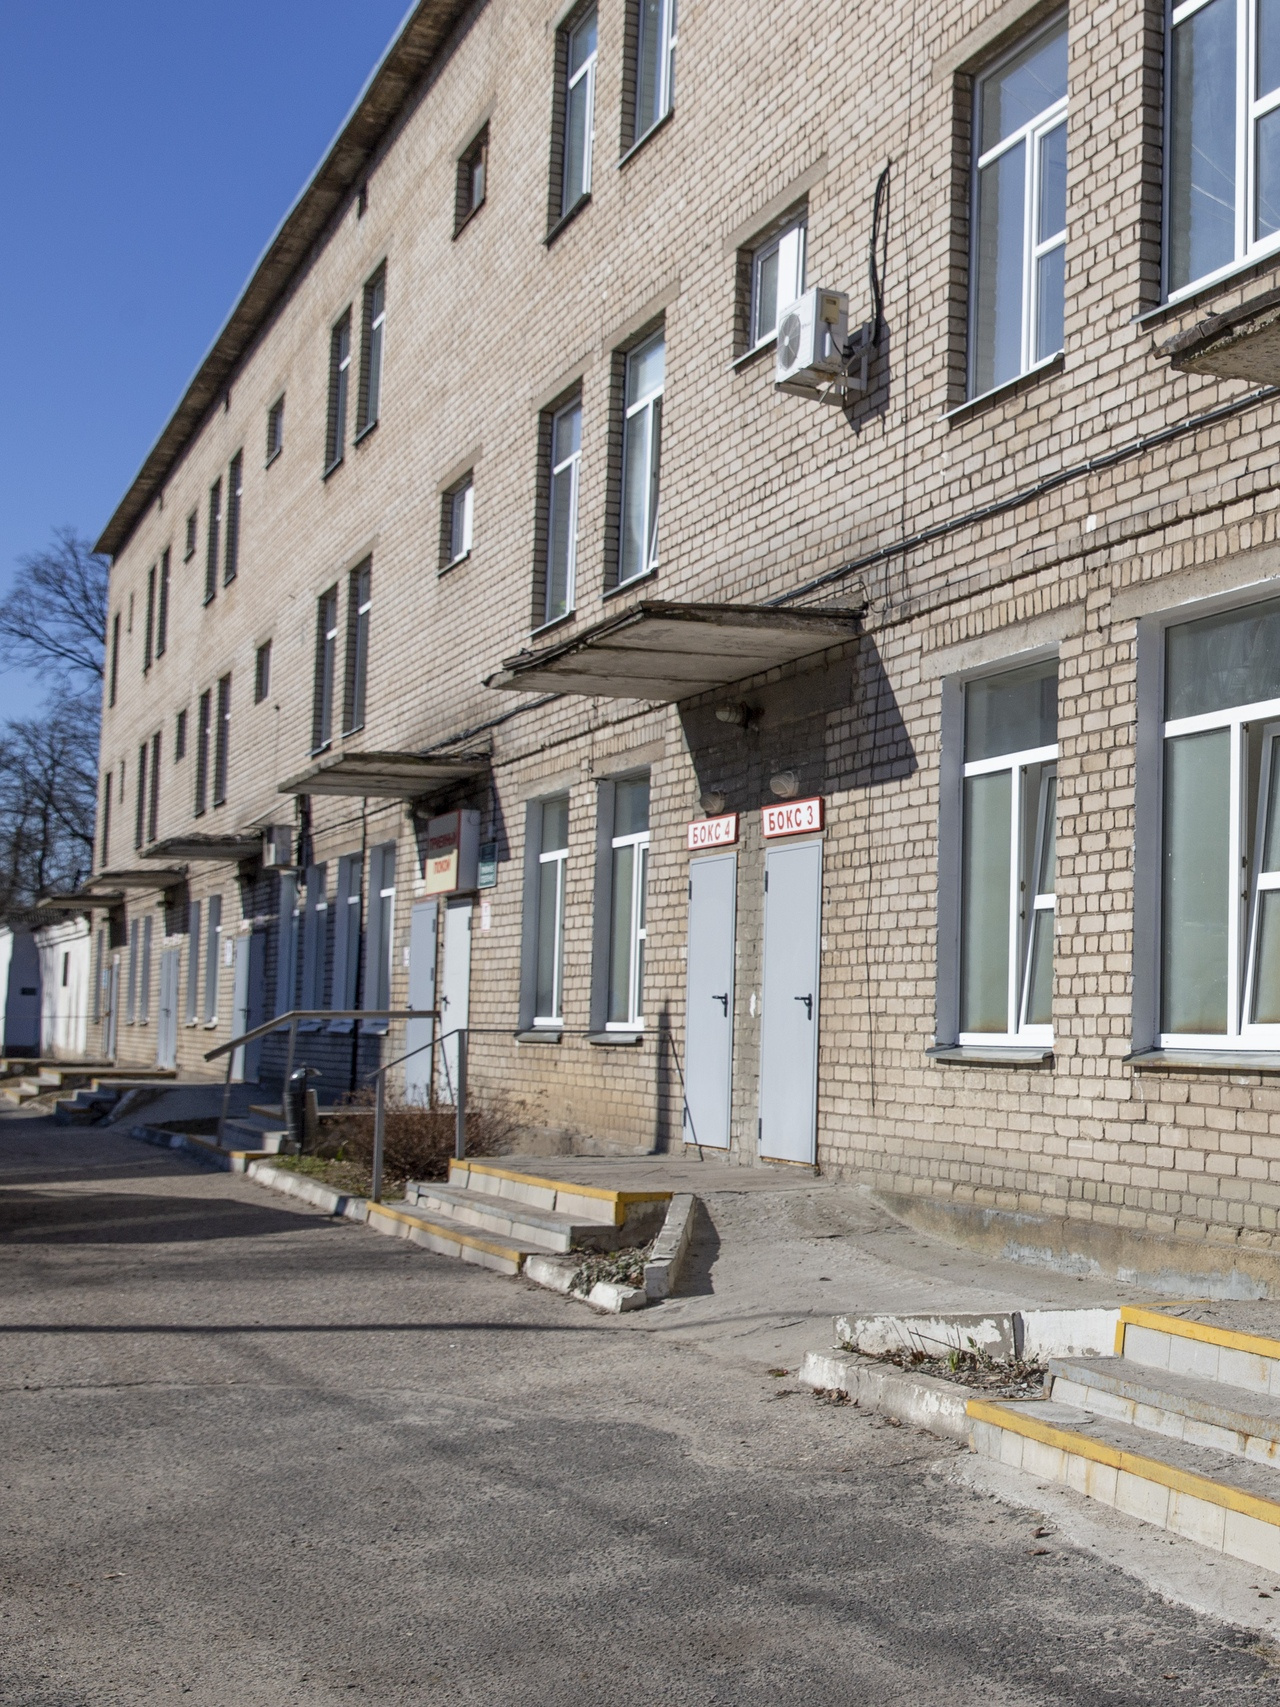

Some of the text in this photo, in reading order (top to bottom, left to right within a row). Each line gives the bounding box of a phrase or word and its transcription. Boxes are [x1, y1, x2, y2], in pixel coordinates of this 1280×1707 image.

[768, 805, 814, 832] БОКС 3
[693, 820, 731, 844] БОКС 4
